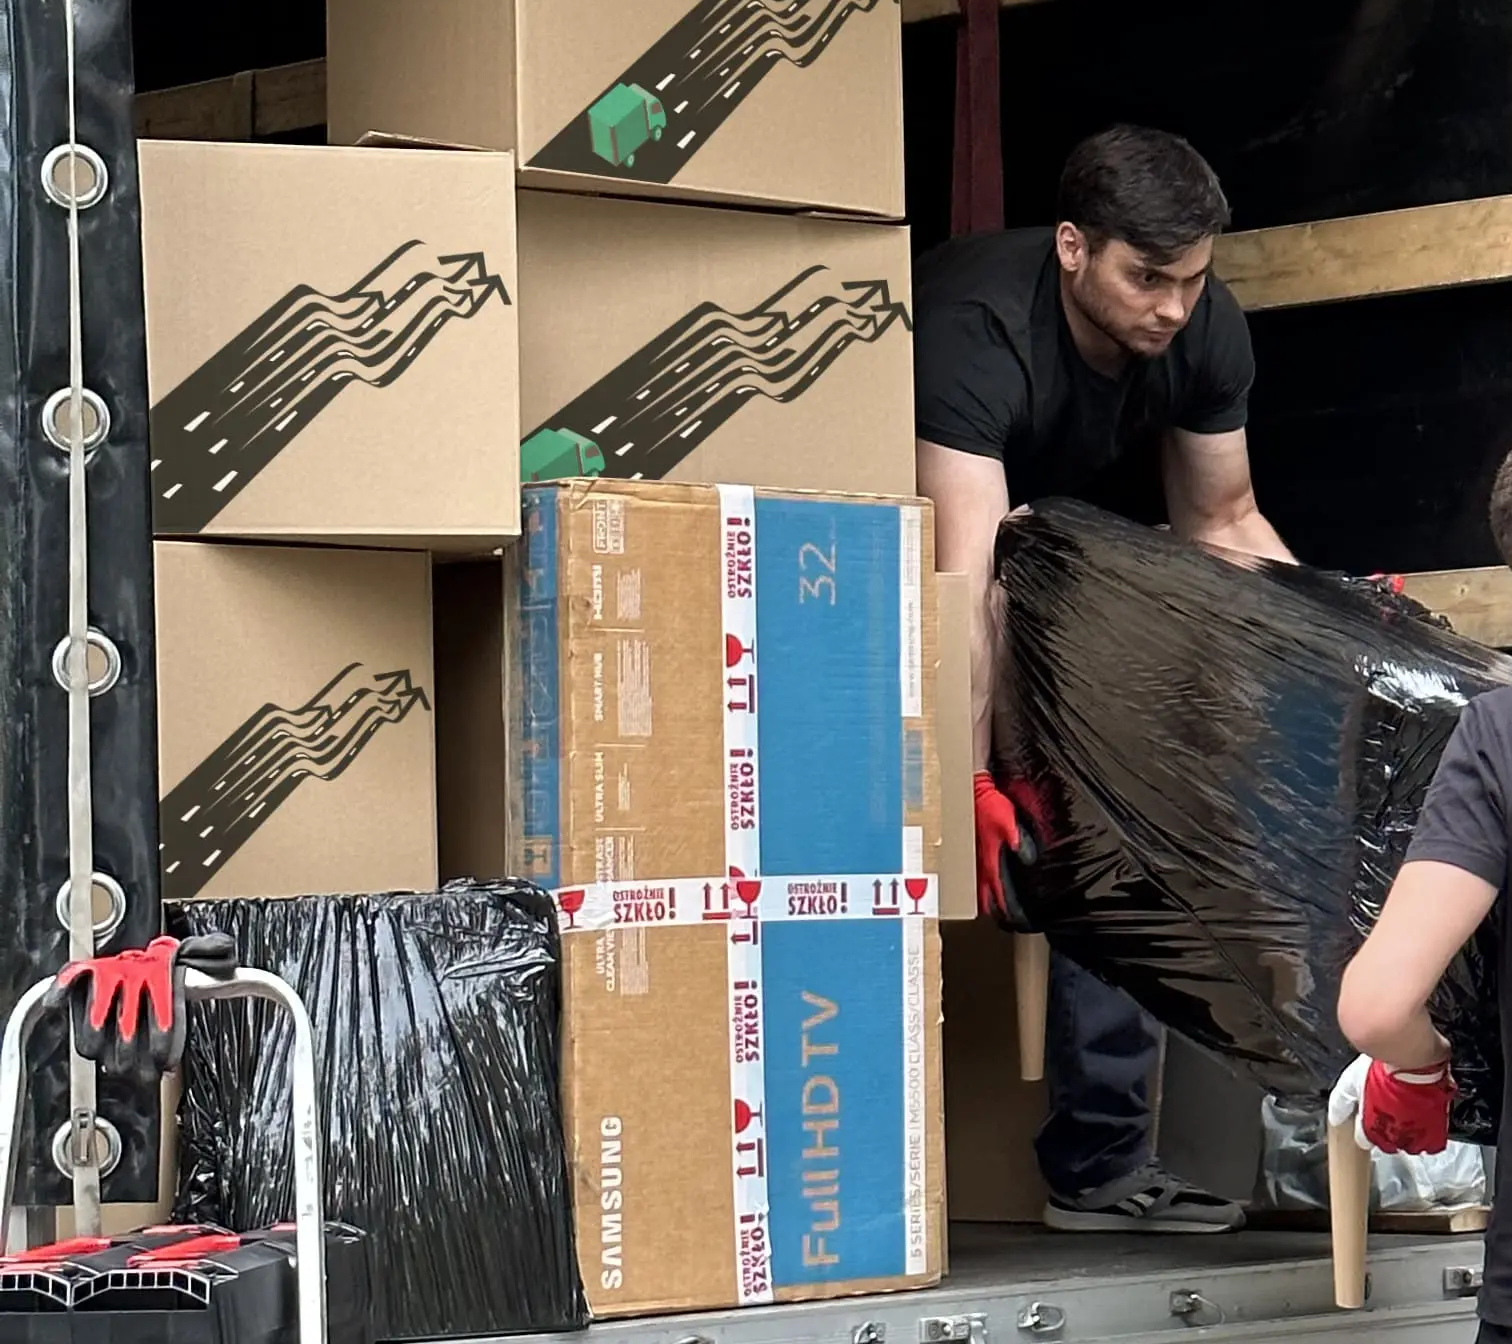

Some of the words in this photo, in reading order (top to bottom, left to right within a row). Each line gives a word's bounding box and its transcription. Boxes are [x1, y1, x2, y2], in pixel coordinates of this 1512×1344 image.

[725, 531, 736, 599] OSTROŻNIE
[799, 542, 836, 606] 32
[594, 752, 604, 781] SLIM
[728, 763, 740, 831] OSTROŻNIE
[594, 783, 605, 822] ULTRA
[595, 936, 605, 974] ULTRA
[732, 996, 743, 1063] OSTROŻNIE
[801, 991, 839, 1068] TV
[801, 1074, 840, 1160] HD
[600, 1116, 623, 1290] SAMSUNG
[801, 1169, 840, 1267] Full
[908, 1135, 921, 1245] SERIES/SERIE
[738, 1229, 752, 1297] OSTROŻNIE
